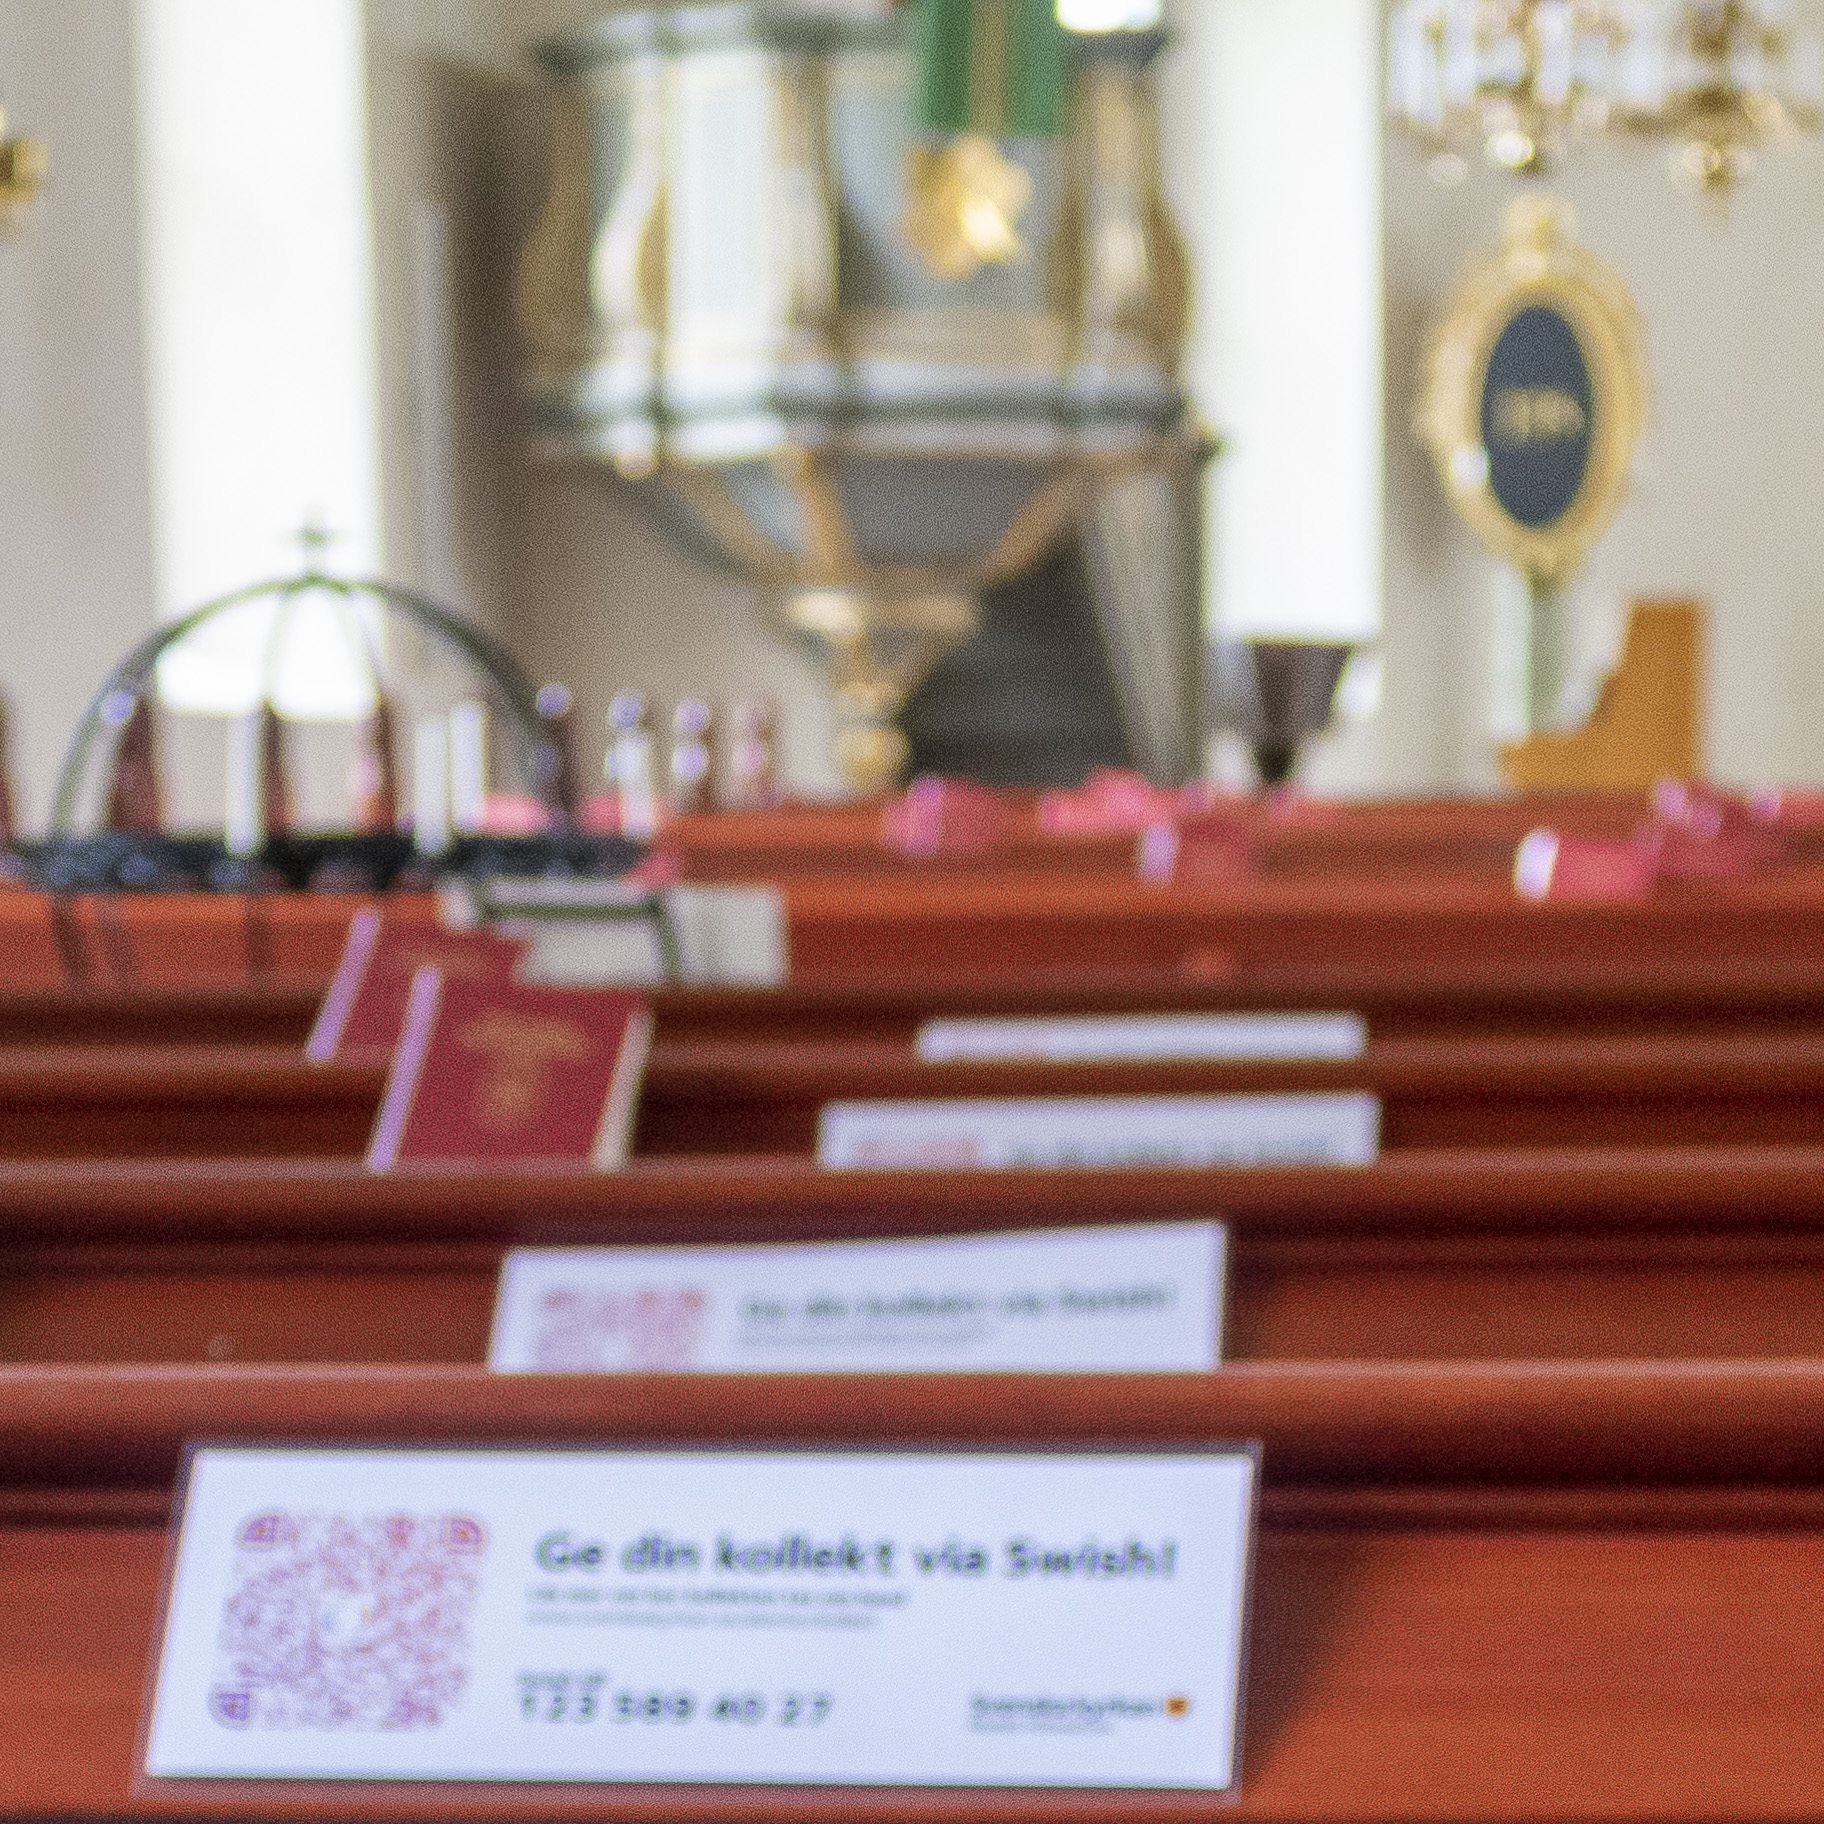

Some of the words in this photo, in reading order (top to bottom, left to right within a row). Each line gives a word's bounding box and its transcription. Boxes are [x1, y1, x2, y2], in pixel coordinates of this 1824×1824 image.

[535, 1532, 604, 1572] Ge
[621, 1534, 699, 1573] din
[716, 1535, 894, 1575] kollekt
[916, 1541, 987, 1576] via
